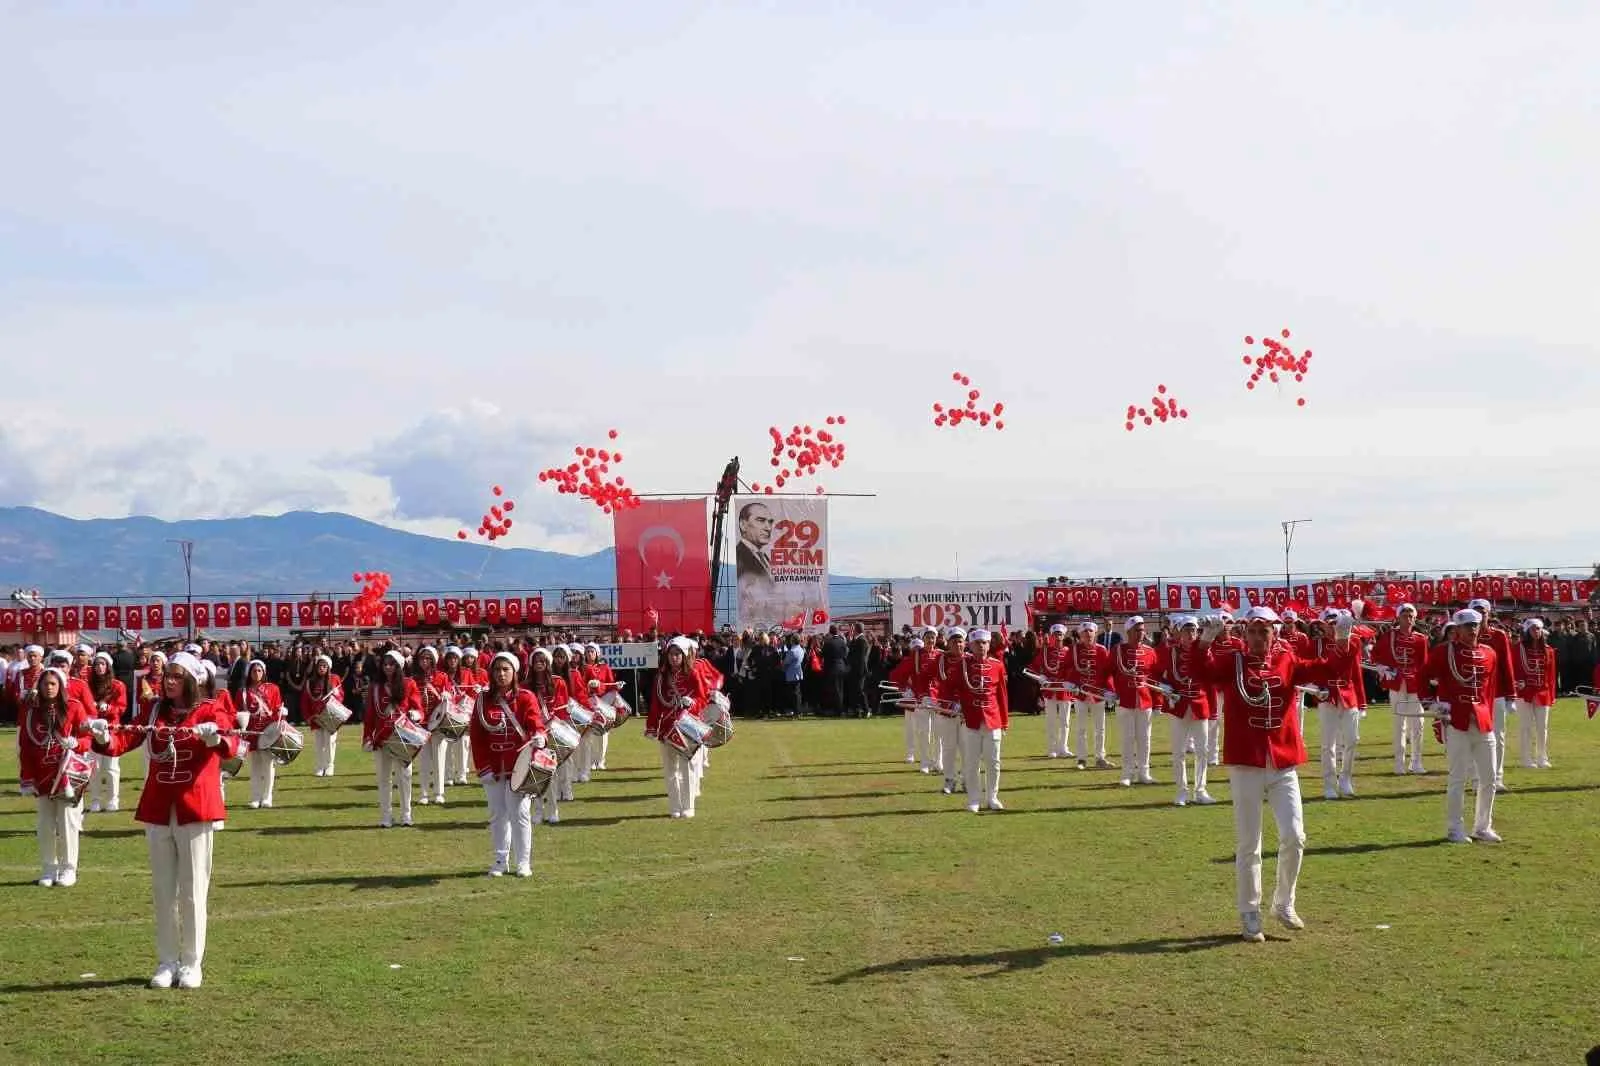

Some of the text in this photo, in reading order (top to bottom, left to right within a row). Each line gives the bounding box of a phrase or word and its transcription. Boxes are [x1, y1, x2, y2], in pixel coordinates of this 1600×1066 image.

[774, 520, 819, 548] 29
[770, 549, 823, 566] EKİM
[600, 645, 622, 655] TİH
